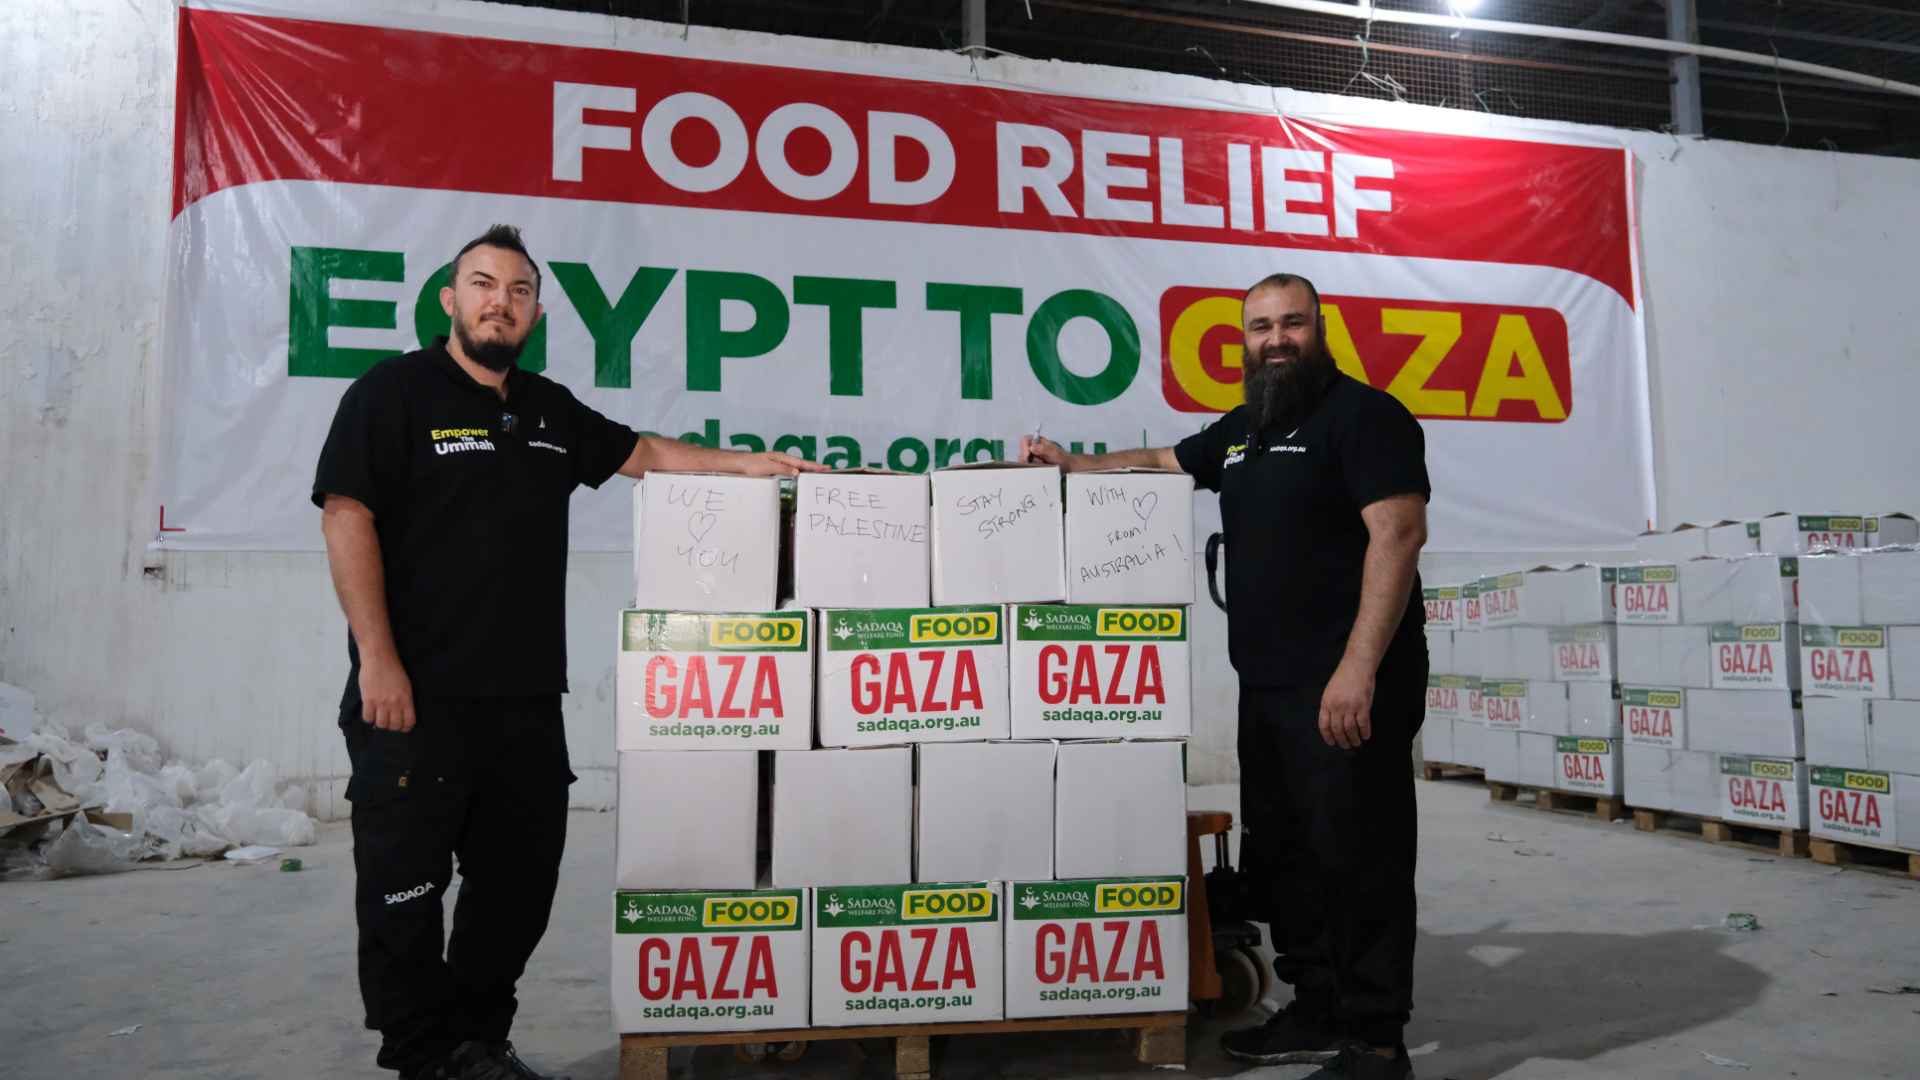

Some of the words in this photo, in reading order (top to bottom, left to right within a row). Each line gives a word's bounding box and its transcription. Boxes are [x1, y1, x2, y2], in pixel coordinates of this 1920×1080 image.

[551, 81, 956, 206] FOOD
[996, 121, 1395, 238] RELIEF
[926, 282, 1141, 406] TO
[431, 428, 489, 440] Empower
[434, 439, 496, 455] Ummah
[668, 484, 726, 512] WE
[816, 486, 889, 510] FREE
[956, 487, 1003, 516] STAY
[809, 512, 929, 543] PALESTINE
[1107, 526, 1142, 546] FROM
[677, 544, 742, 575] YOU
[1484, 589, 1519, 616] GAZA
[1624, 583, 1669, 612] GAZA
[1045, 613, 1091, 625] SADAQA
[1104, 612, 1175, 632] FOOD
[1426, 600, 1454, 621] GAZA
[717, 622, 796, 641] FOOD
[856, 621, 904, 633] SADAQA
[916, 616, 990, 637] FOOD
[1560, 644, 1600, 669] GAZA
[1719, 643, 1773, 673] GAZA
[1811, 648, 1874, 683] GAZA
[645, 654, 784, 719] GAZA
[850, 649, 984, 715] GAZA
[1038, 644, 1166, 705] GAZA
[1428, 688, 1458, 709] GAZA
[1487, 697, 1520, 721] GAZA
[856, 715, 981, 732] sadaqa.org.au
[1042, 708, 1162, 725] sadaqa.org.au
[1629, 707, 1673, 738] GAZA
[649, 722, 780, 738] sadaqa.org.au
[1563, 754, 1605, 781] GAZA
[1847, 774, 1885, 789] FOOD
[1728, 777, 1786, 813] GAZA
[1819, 787, 1882, 829] GAZA
[383, 881, 435, 905] SADAQA
[847, 898, 896, 910] SADAQA
[910, 892, 985, 914] FOOD
[1043, 889, 1089, 902] SADAQA
[1102, 886, 1175, 907] FOOD
[646, 904, 697, 916] SADAQA
[711, 901, 790, 922] FOOD
[840, 927, 977, 993] GAZA
[1034, 919, 1165, 985] GAZA
[638, 935, 778, 1001] GAZA
[844, 994, 973, 1011] sadaqa.org.au
[1039, 984, 1161, 1002] sadaqa.org.au
[642, 1003, 774, 1020] sadaqa.org.au
